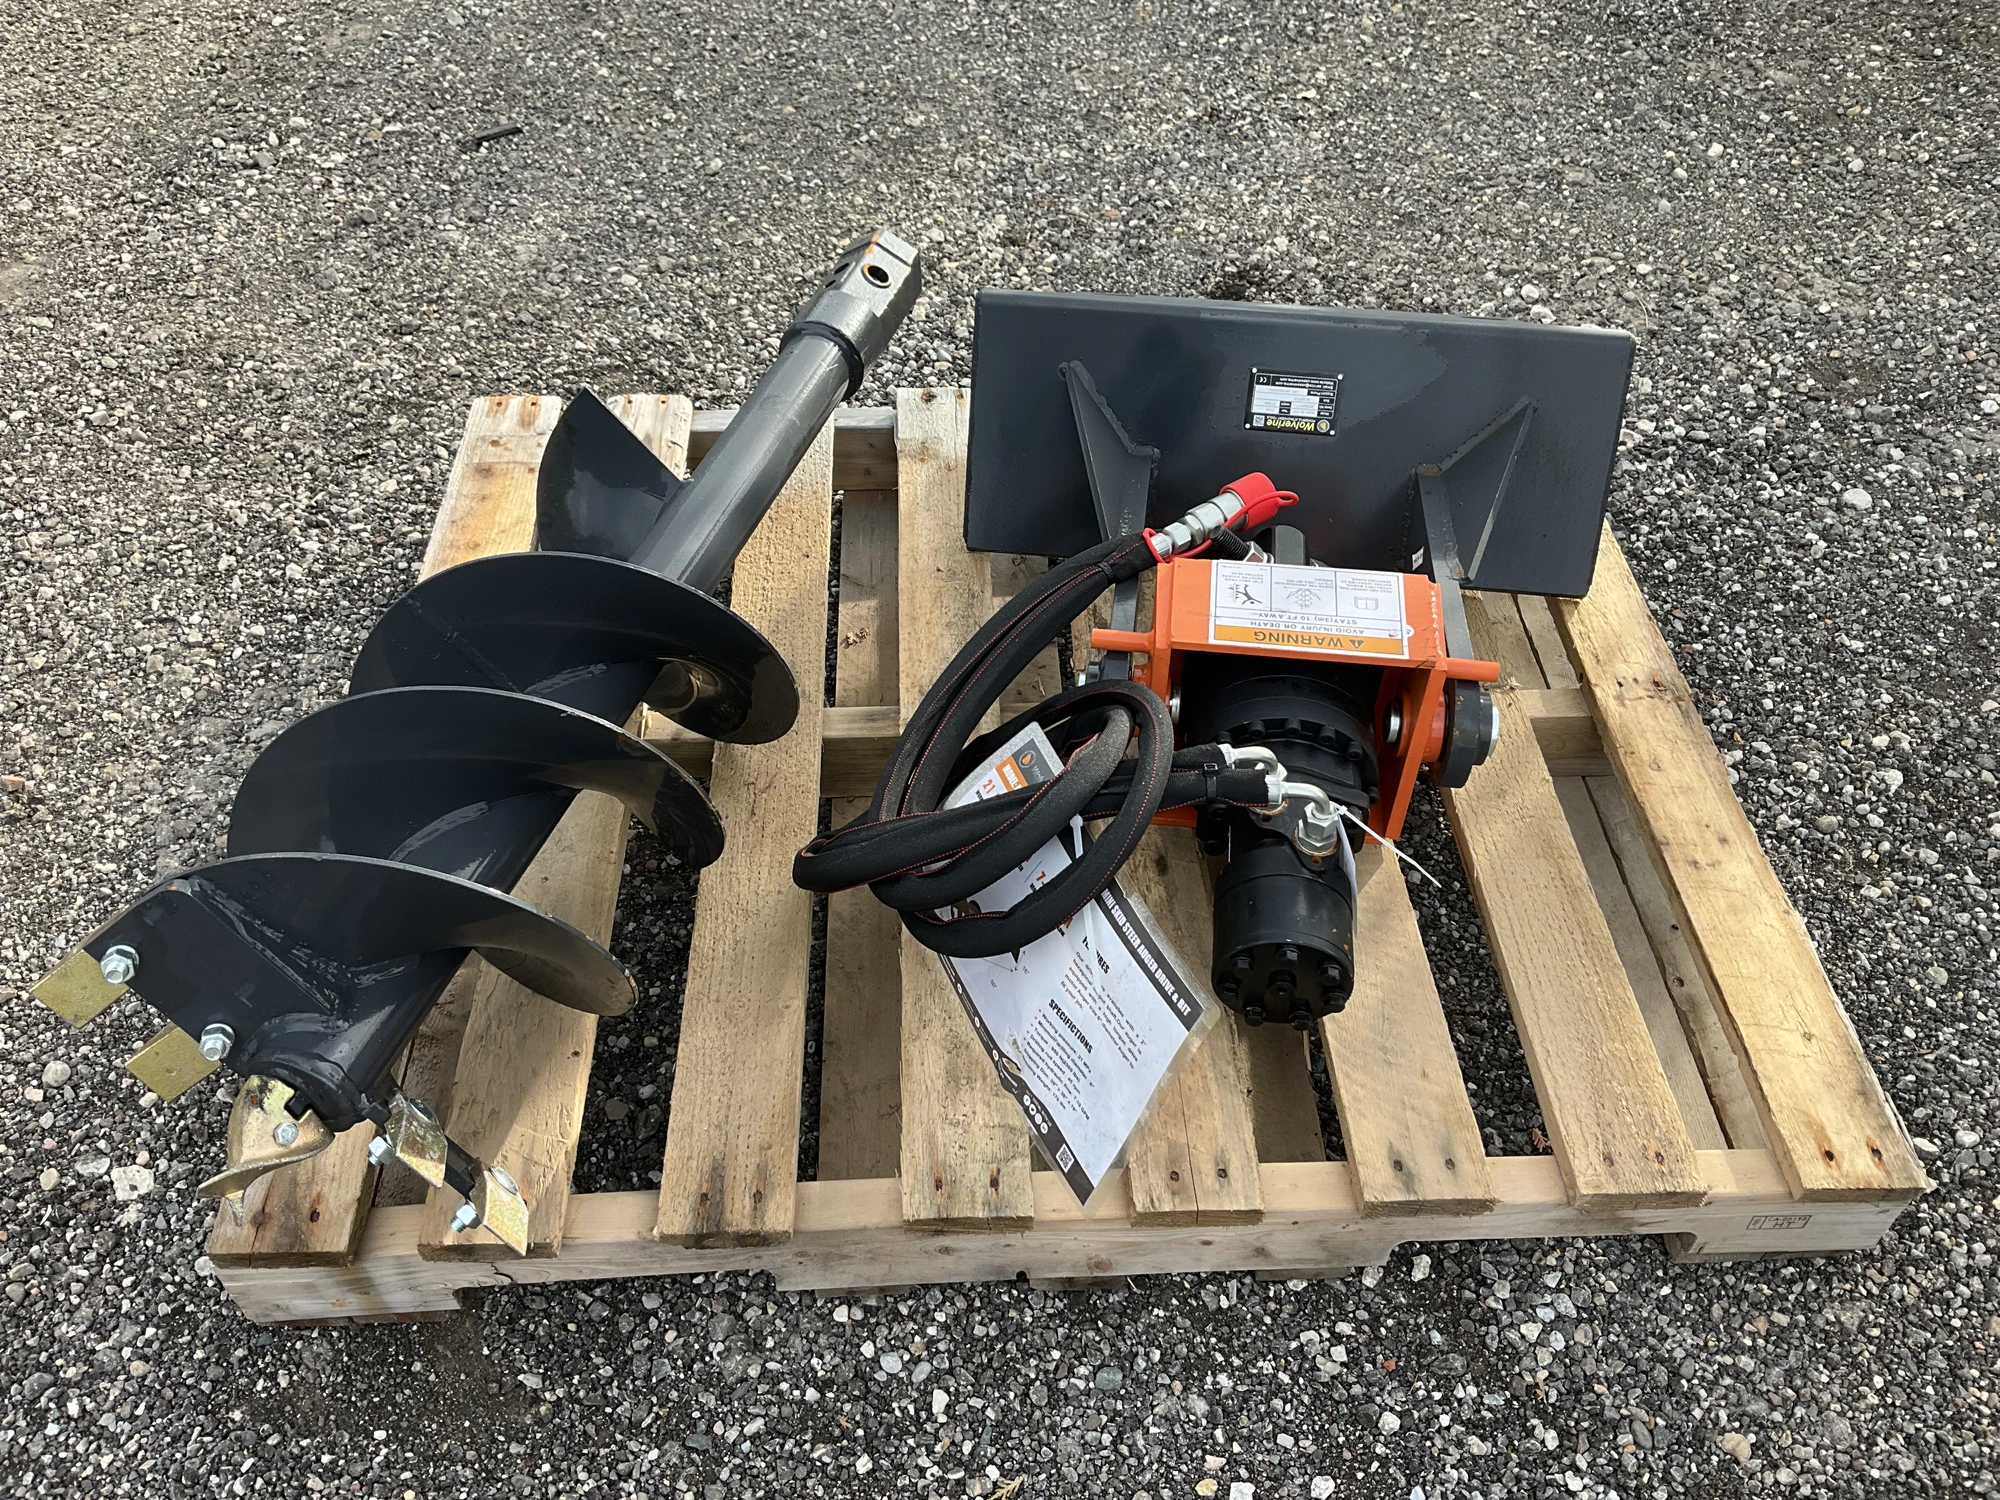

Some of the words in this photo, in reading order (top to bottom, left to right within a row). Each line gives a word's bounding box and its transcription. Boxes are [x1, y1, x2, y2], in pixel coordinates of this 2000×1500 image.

[1266, 419, 1315, 431] Wolverine
[1314, 616, 1357, 625] STAY(3m)
[1336, 627, 1364, 635] AVOID
[1253, 631, 1344, 648] WARNING
[1101, 889, 1116, 909] MINI
[1111, 905, 1126, 926] SKID
[1123, 923, 1141, 948] STEER
[1137, 945, 1158, 972] AUGER
[1155, 970, 1175, 995] DRIVE
[1172, 993, 1178, 1003] &
[1177, 999, 1191, 1016] BIT
[1065, 988, 1076, 999] your
[1073, 958, 1093, 986] hexagonal
[1125, 1031, 1137, 1047] auger
[1042, 1013, 1058, 1034] Working
[1049, 999, 1093, 1053] SPECIFICTIONS
[1065, 974, 1078, 989] motor
[1077, 989, 1089, 1005] Auger
[1102, 1023, 1118, 1046] diameter
[1118, 1046, 1130, 1062] auger
[1069, 967, 1087, 991] equipped
[1089, 993, 1097, 1004] with
[1103, 1012, 1112, 1025] high
[1113, 1026, 1126, 1045] torque
[1128, 1048, 1138, 1062] drive
[1106, 994, 1124, 1017] available
[1126, 1020, 1134, 1031] with
[1034, 1027, 1048, 1045] Torque
[1030, 1034, 1045, 1052] Drilling
[1045, 1052, 1053, 1060] rod
[1053, 1060, 1065, 1075] speed
